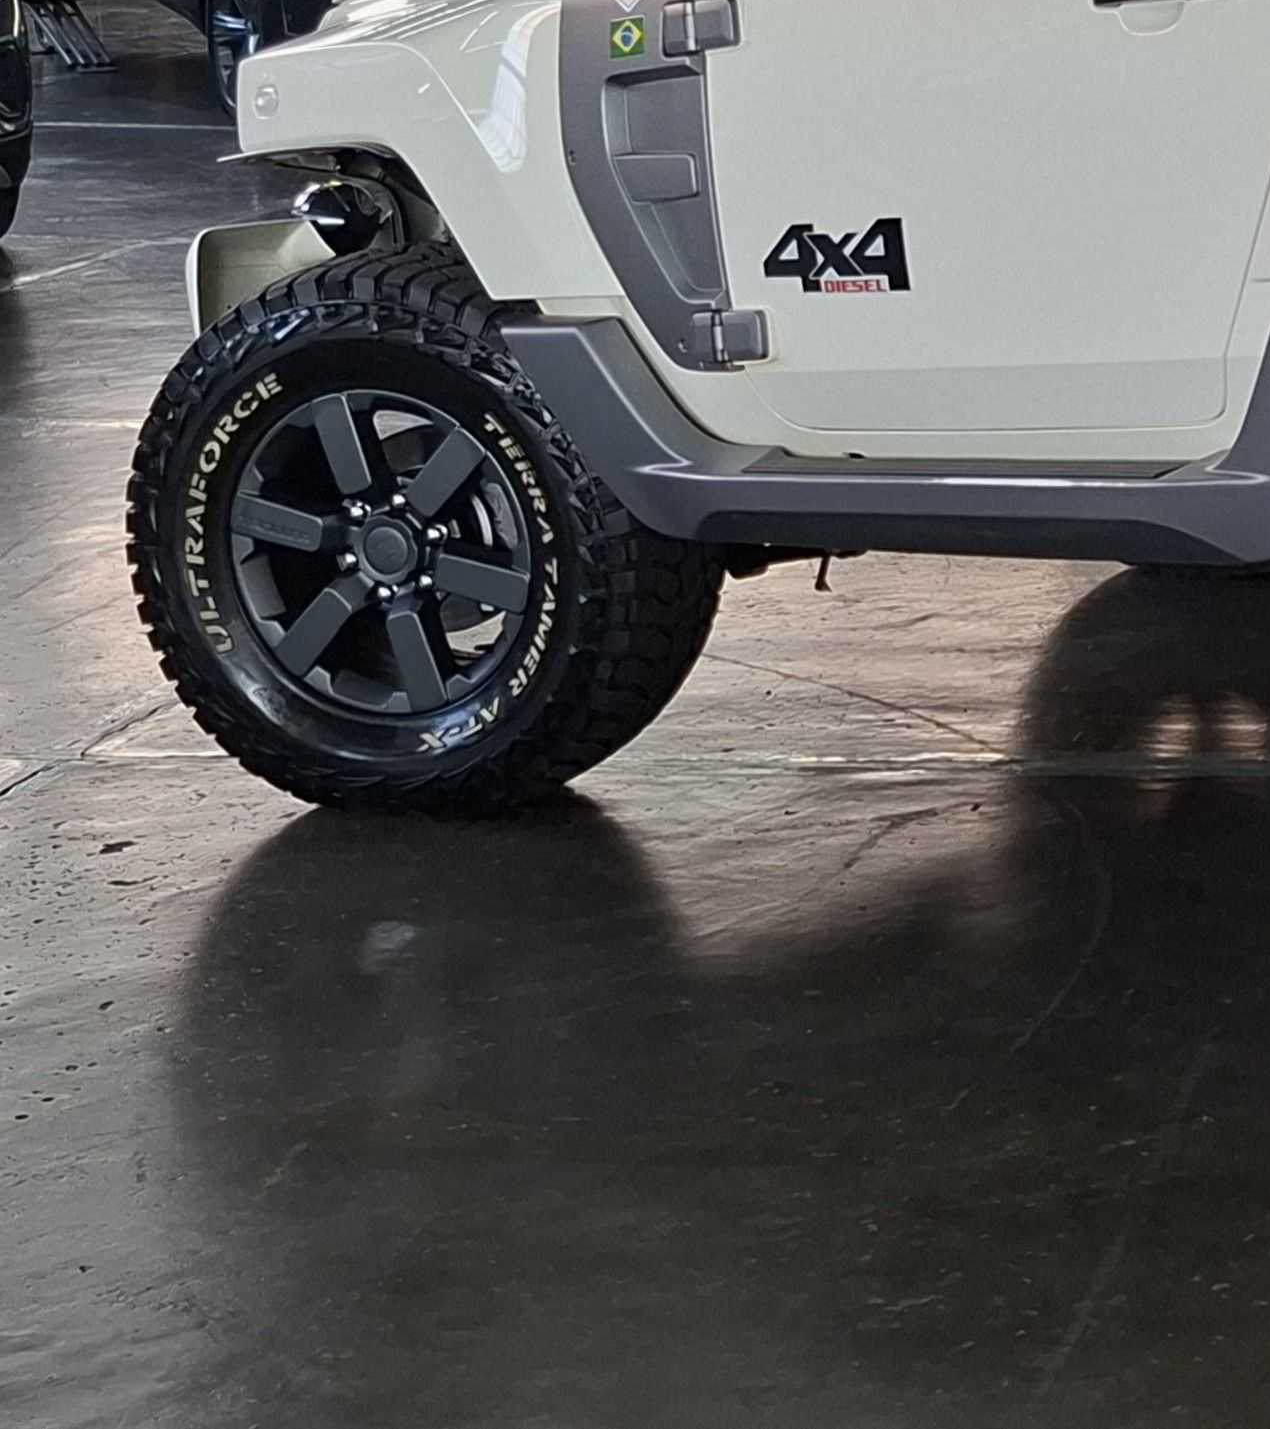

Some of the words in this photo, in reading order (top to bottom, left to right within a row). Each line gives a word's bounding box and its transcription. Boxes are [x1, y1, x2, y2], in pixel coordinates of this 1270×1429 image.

[763, 217, 911, 293] 4x4
[823, 280, 888, 293] DIESEL
[182, 373, 283, 655] ULTRAFORCE
[482, 412, 554, 545] TERRA
[509, 557, 559, 699] TAMER
